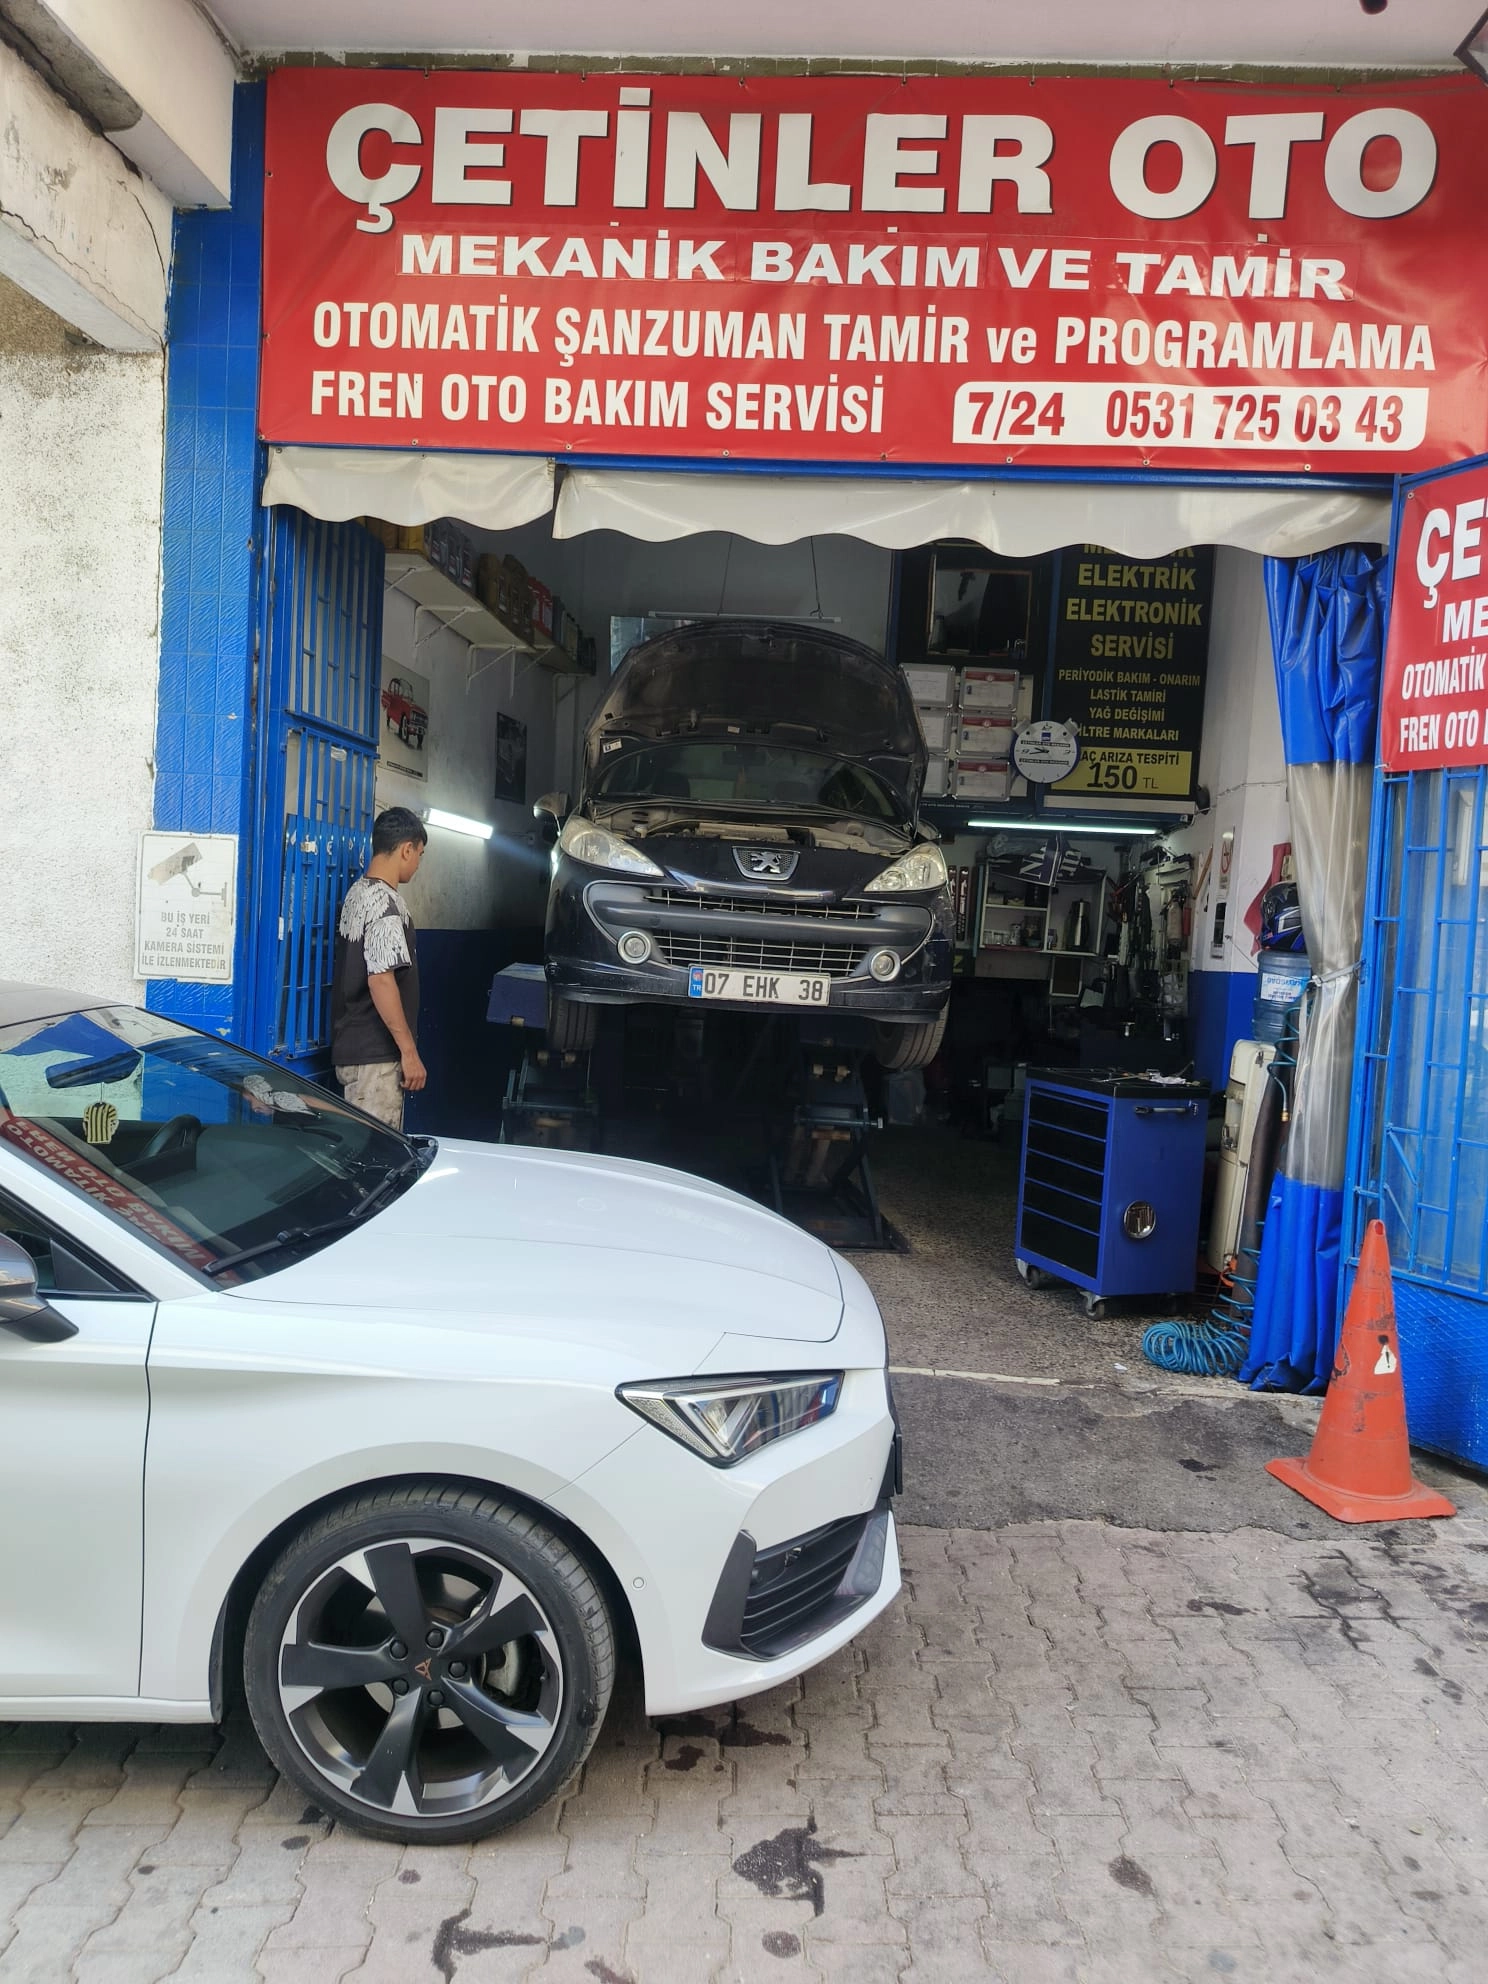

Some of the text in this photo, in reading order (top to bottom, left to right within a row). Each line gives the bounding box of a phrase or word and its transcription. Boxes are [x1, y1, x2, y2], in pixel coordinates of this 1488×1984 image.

[326, 86, 1437, 233] ÇETİNLER OTO
[401, 229, 1347, 300] MEKANİK BAKIM VE TAMİR
[313, 294, 1436, 371] OTOMATİK ŞANZUMAN TAMİR ve PROGRAMLAMA
[311, 370, 884, 434] FREN OTO BAKIM SERVİSİ
[968, 390, 1403, 442] 7/24 0531 725 03 43
[1416, 496, 1488, 609] ÇE
[1078, 562, 1197, 591] ELEKTRİK
[1065, 597, 1203, 626] ELEKTRONİK
[1090, 632, 1174, 660] SERVİSİ
[1058, 667, 1114, 683] PERİYODİK
[1116, 671, 1151, 684] BAKIM
[1159, 673, 1201, 687] ONARIM
[1401, 646, 1487, 701] OTOMATİK
[1089, 687, 1166, 703] LASTİK TAMİRİ
[1089, 705, 1165, 723] YAĞ DEĞİŞİMİ
[1077, 722, 1179, 741] İLTRE MARKALARI
[1399, 714, 1440, 753] FREN
[1444, 708, 1480, 750] OTO
[1080, 750, 1097, 765] AÇ
[1099, 751, 1134, 764] ARIZA
[1136, 751, 1180, 766] TESPİTİ
[1086, 761, 1159, 790] 150 TL
[161, 909, 210, 926] BU İŞ YERİ
[166, 926, 205, 939] 24 SAAT
[141, 952, 227, 970] İLE İZLENMEKTEDİR
[144, 940, 225, 955] KAMERA SİSTEMİ
[703, 972, 730, 996] 07
[742, 975, 780, 999] EHK
[798, 979, 824, 1002] 38
